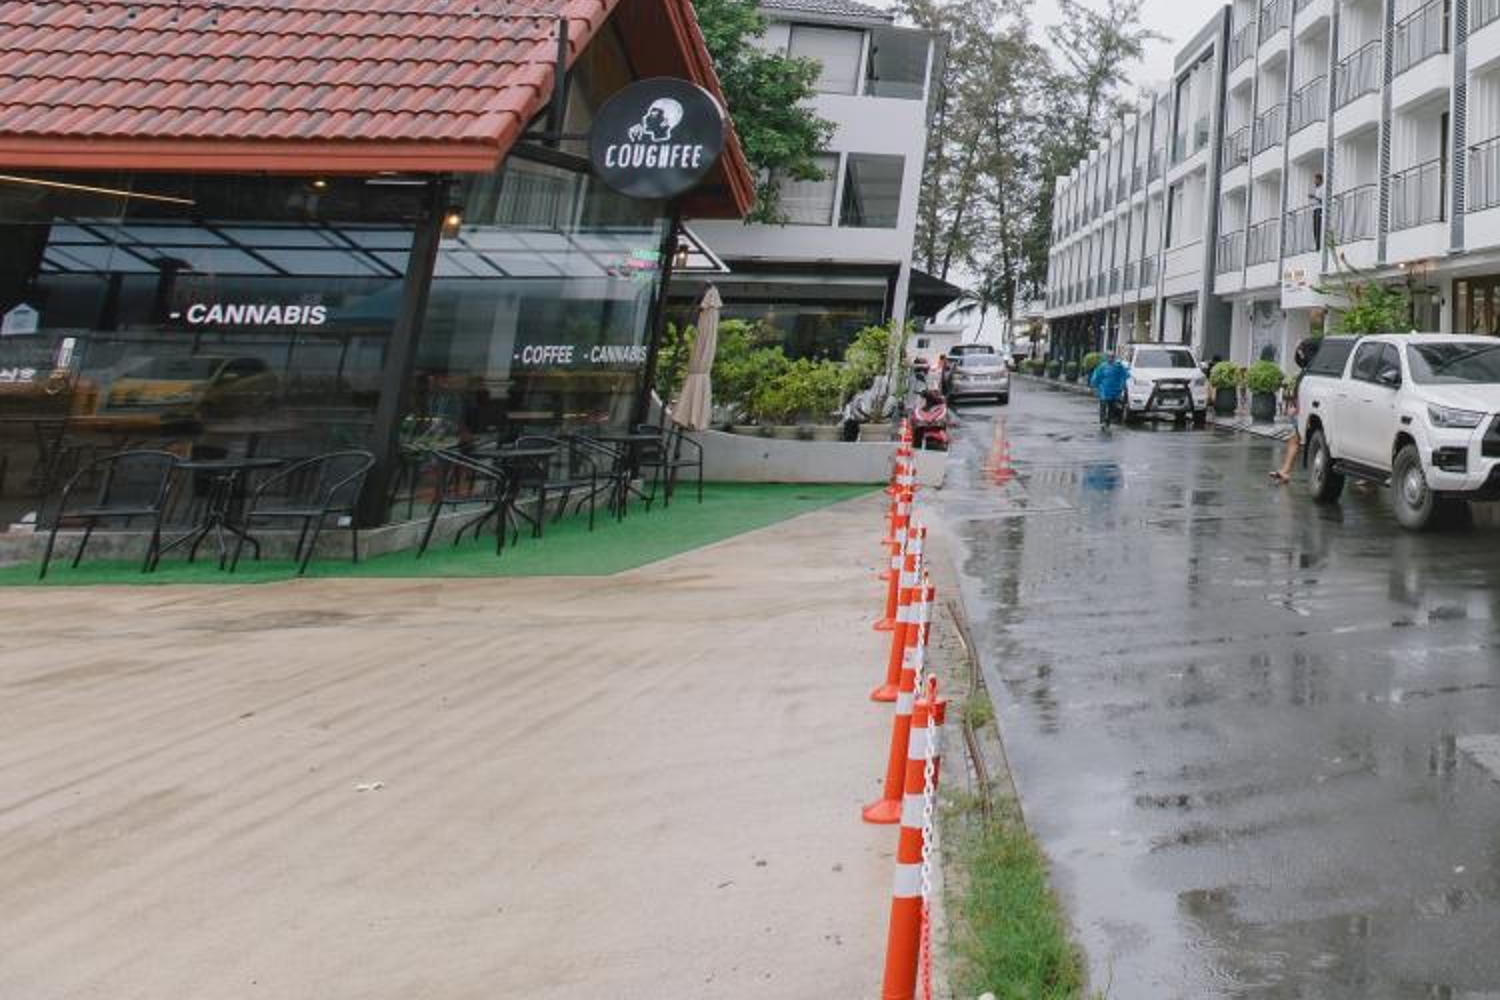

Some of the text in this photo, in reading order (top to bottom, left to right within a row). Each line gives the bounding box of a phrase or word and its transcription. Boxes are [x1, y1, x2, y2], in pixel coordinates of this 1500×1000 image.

[186, 303, 327, 326] CANNABIS
[522, 345, 648, 363] COFFEE CANNABIS
